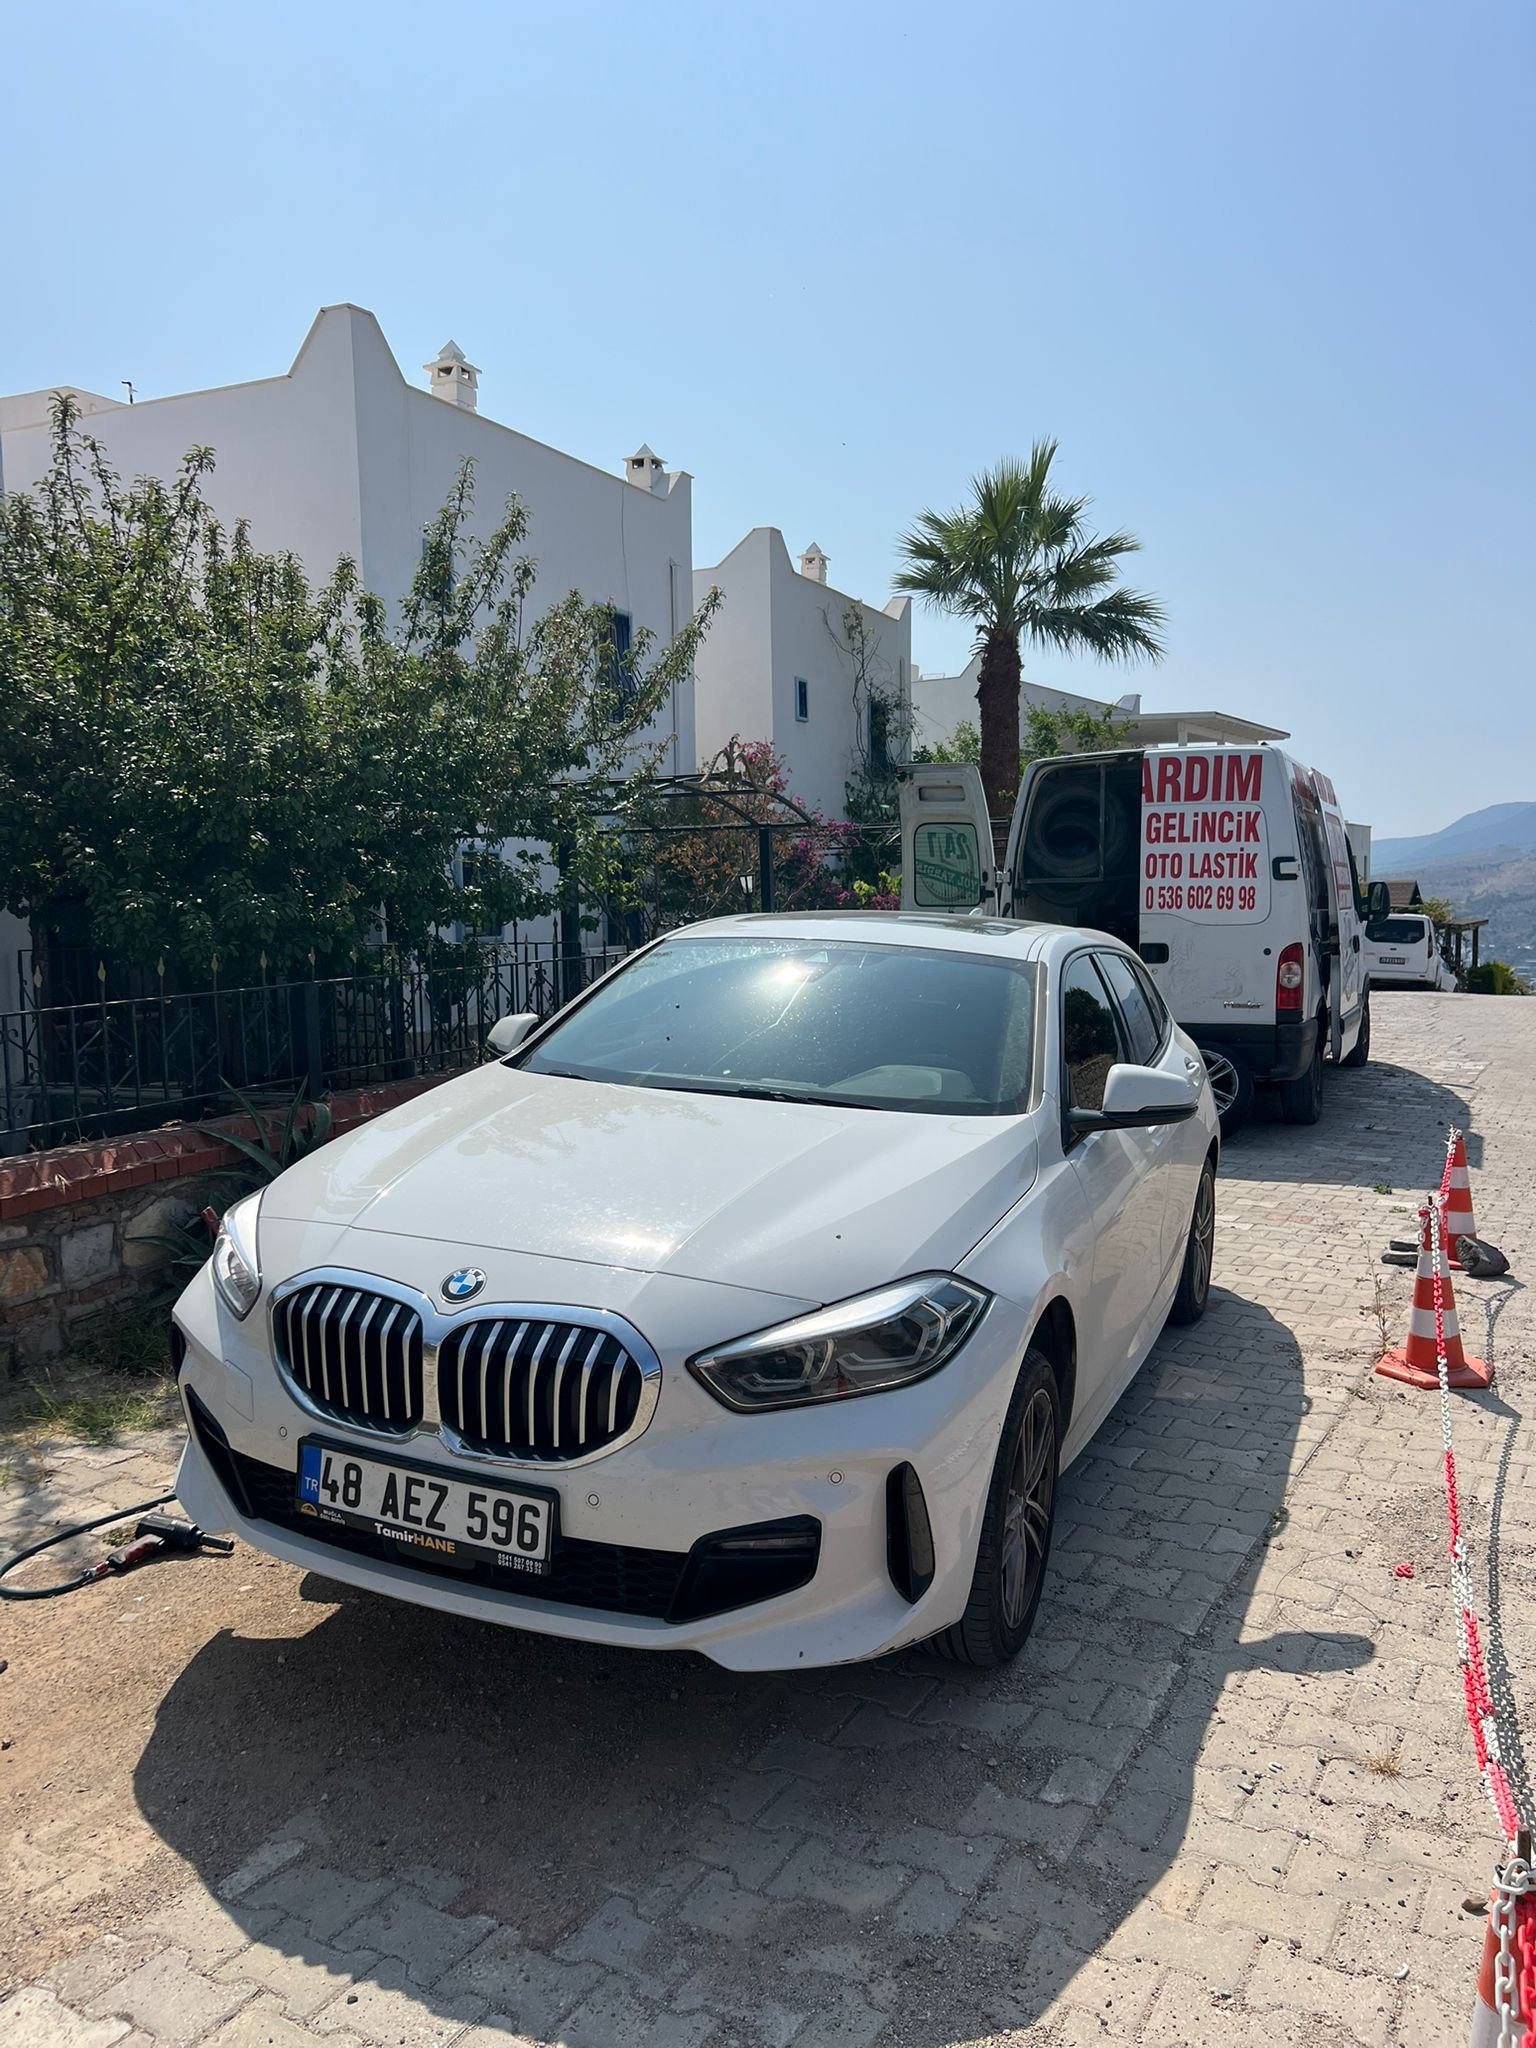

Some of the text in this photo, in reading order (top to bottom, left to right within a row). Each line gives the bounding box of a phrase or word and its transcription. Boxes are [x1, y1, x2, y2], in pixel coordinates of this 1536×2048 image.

[1145, 847, 1258, 879] OTO LASTİK
[1145, 885, 1256, 910] 0 536 602 69 98
[304, 1476, 319, 1492] TR
[321, 1456, 541, 1552] 48 AEZ 596
[374, 1522, 456, 1555] TamirHANE
